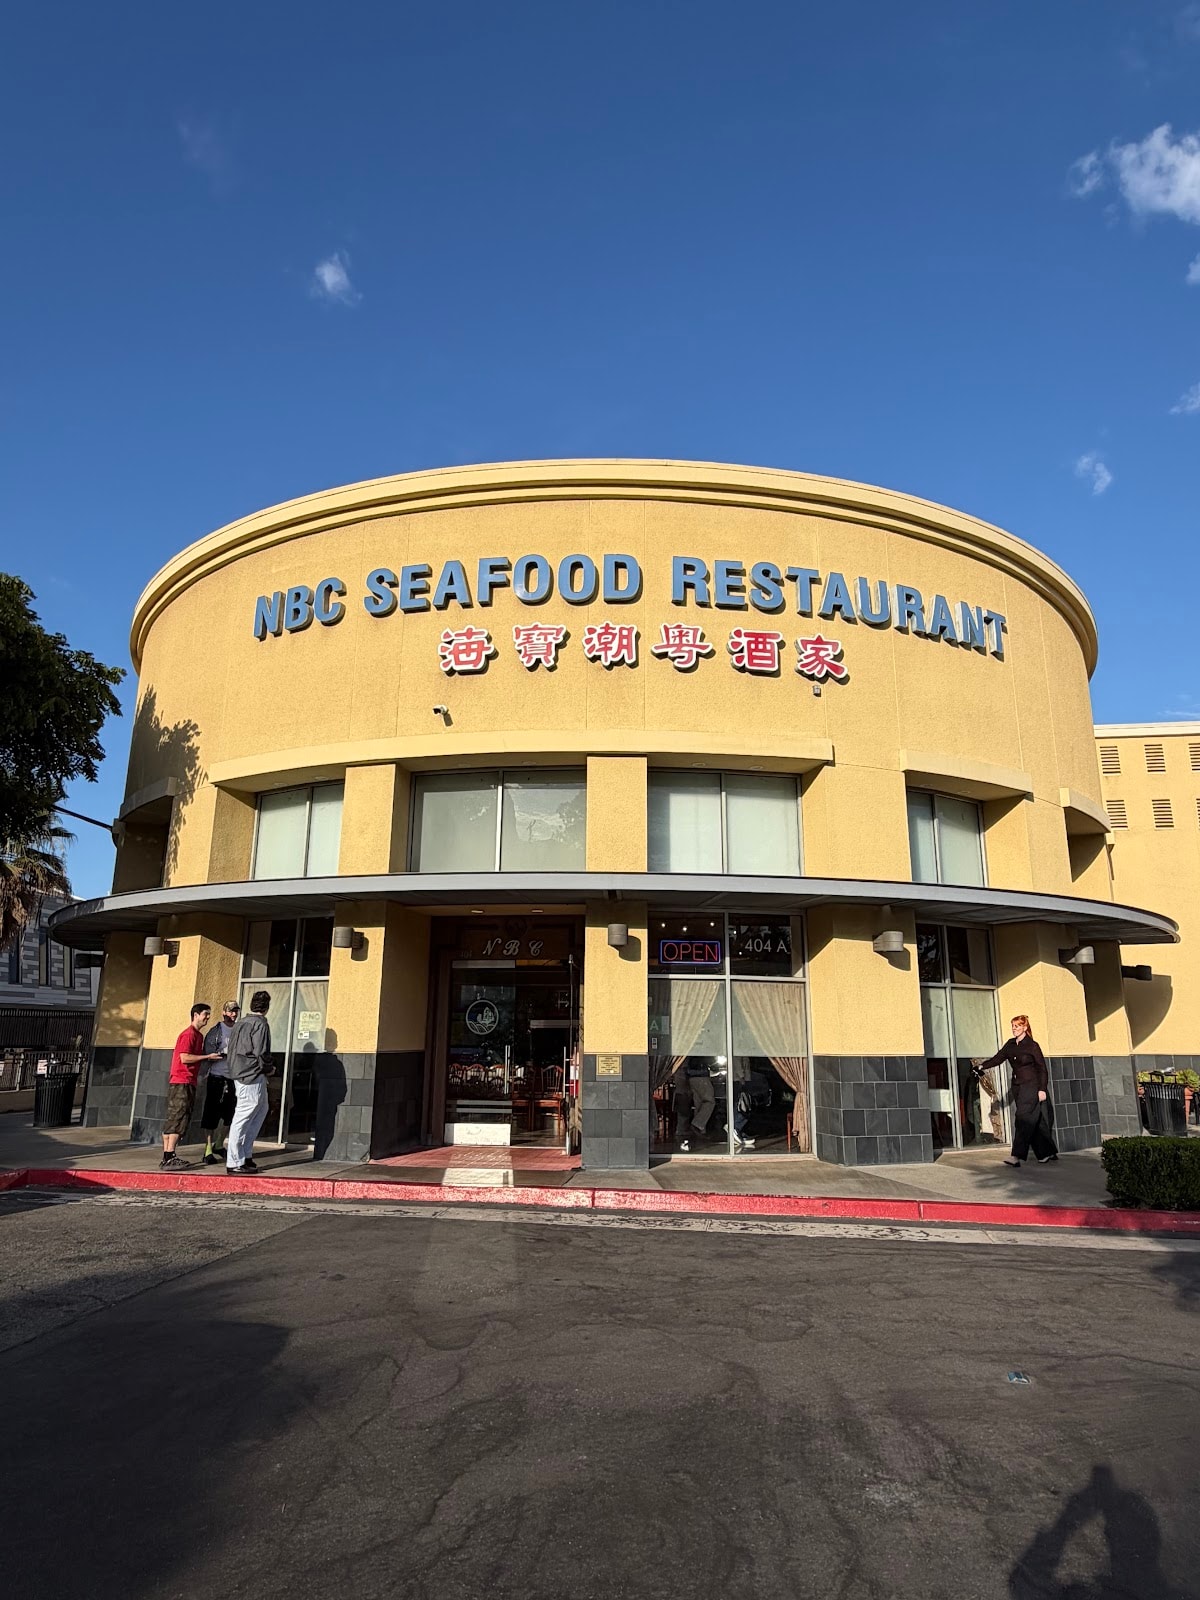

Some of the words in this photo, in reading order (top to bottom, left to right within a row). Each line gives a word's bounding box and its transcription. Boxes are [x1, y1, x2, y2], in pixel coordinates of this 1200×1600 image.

[253, 576, 346, 641] NBC
[364, 553, 642, 617] SEAFOOD
[671, 556, 1008, 661] RESTAURANT
[663, 942, 718, 962] OPEN
[744, 938, 772, 953] 404
[776, 939, 788, 953] A
[649, 1019, 659, 1030] A
